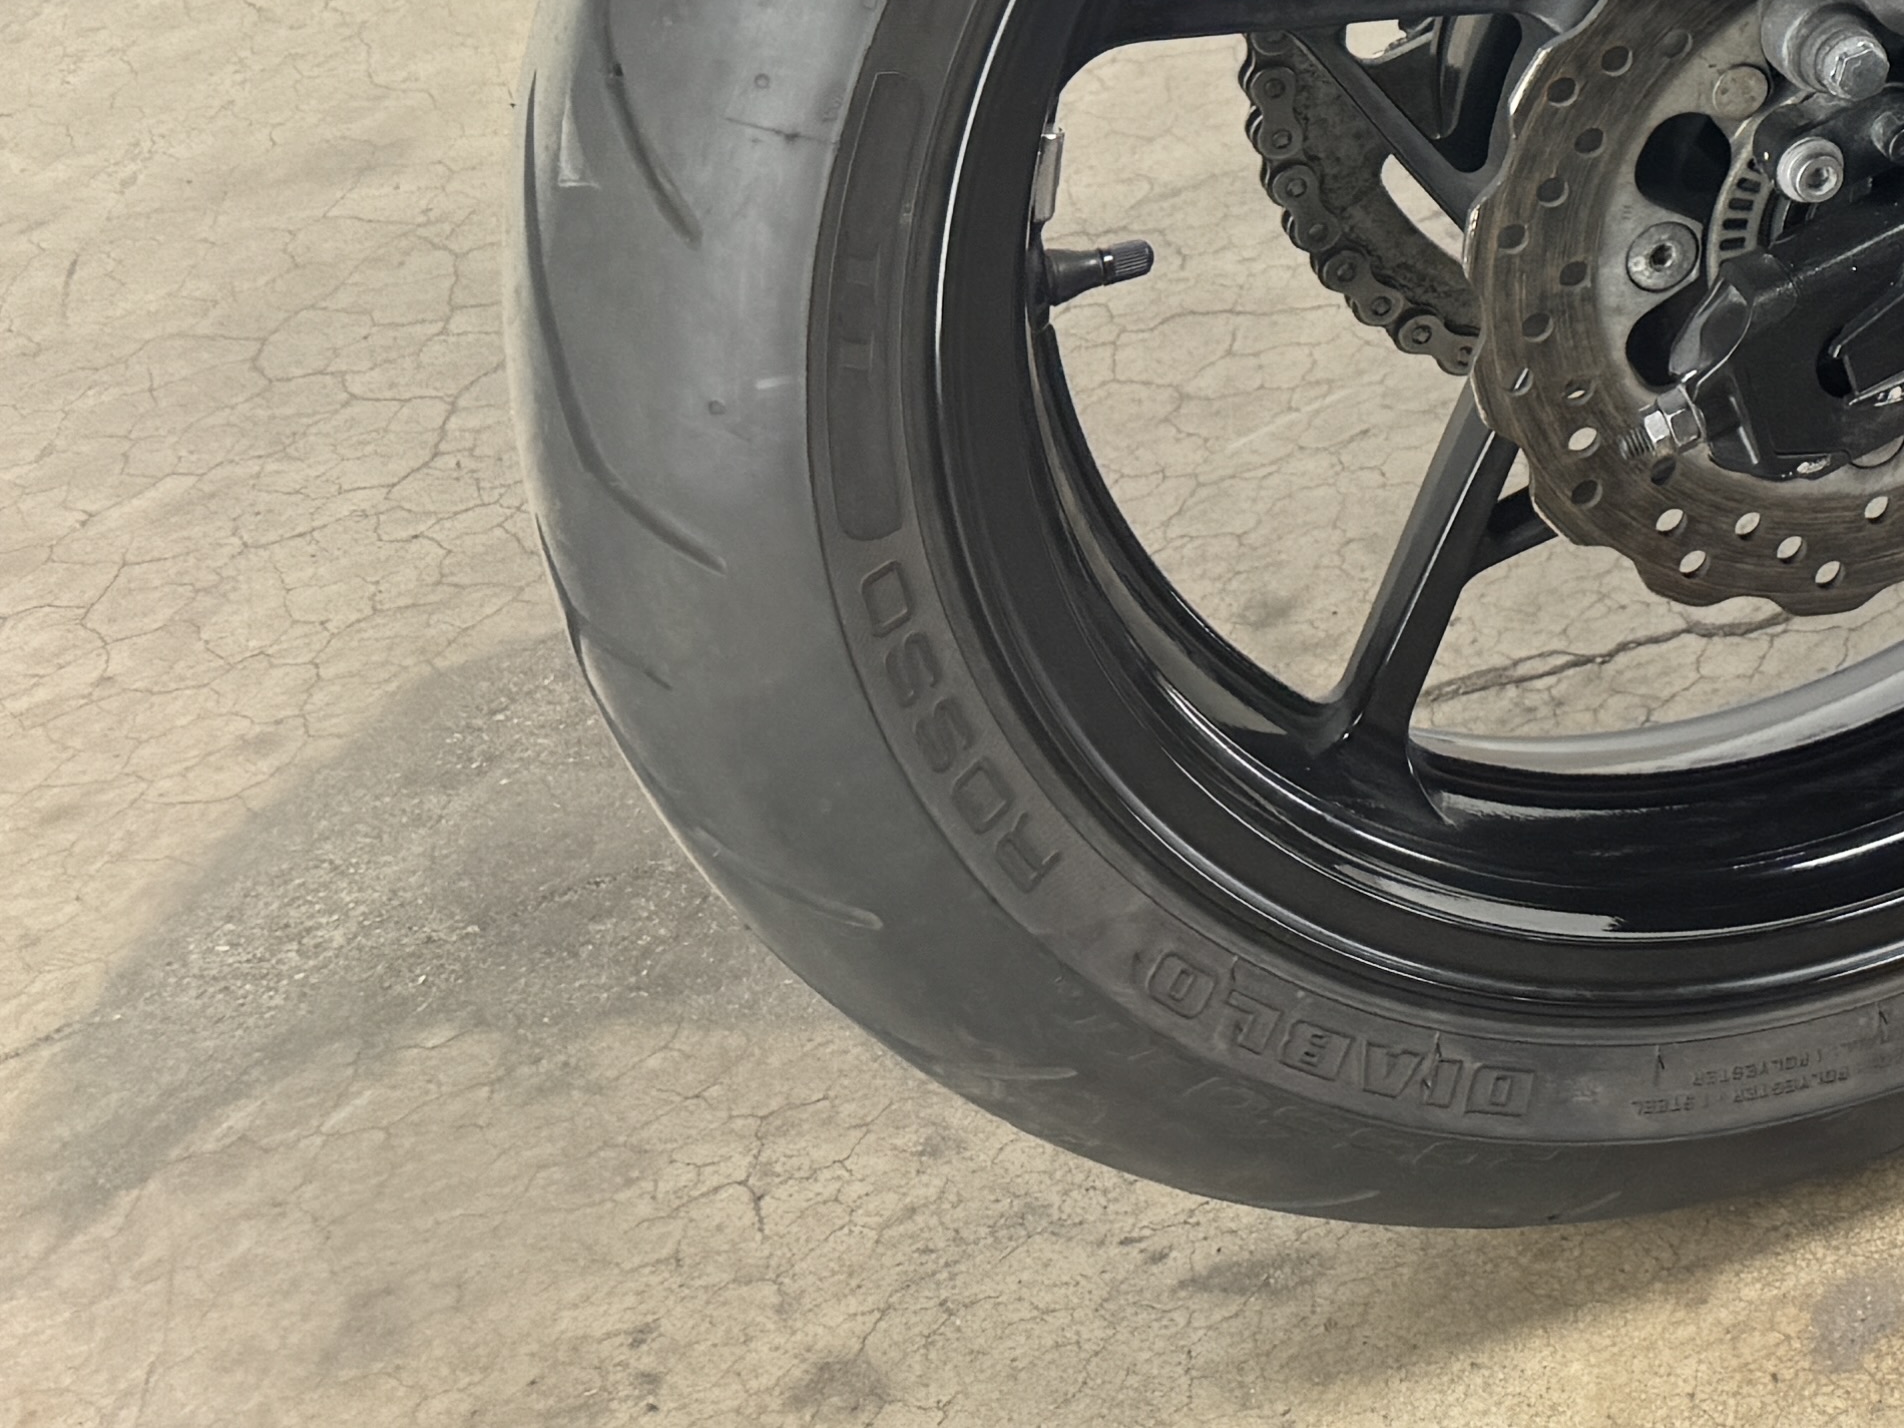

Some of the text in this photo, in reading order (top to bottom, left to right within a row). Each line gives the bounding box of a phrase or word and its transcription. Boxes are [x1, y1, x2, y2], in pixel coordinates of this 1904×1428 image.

[858, 558, 1061, 892] ROSSO
[1142, 947, 1540, 1118] DIABLO
[1692, 1054, 1811, 1087] POLYESTER
[1630, 1095, 1696, 1116] STEEL
